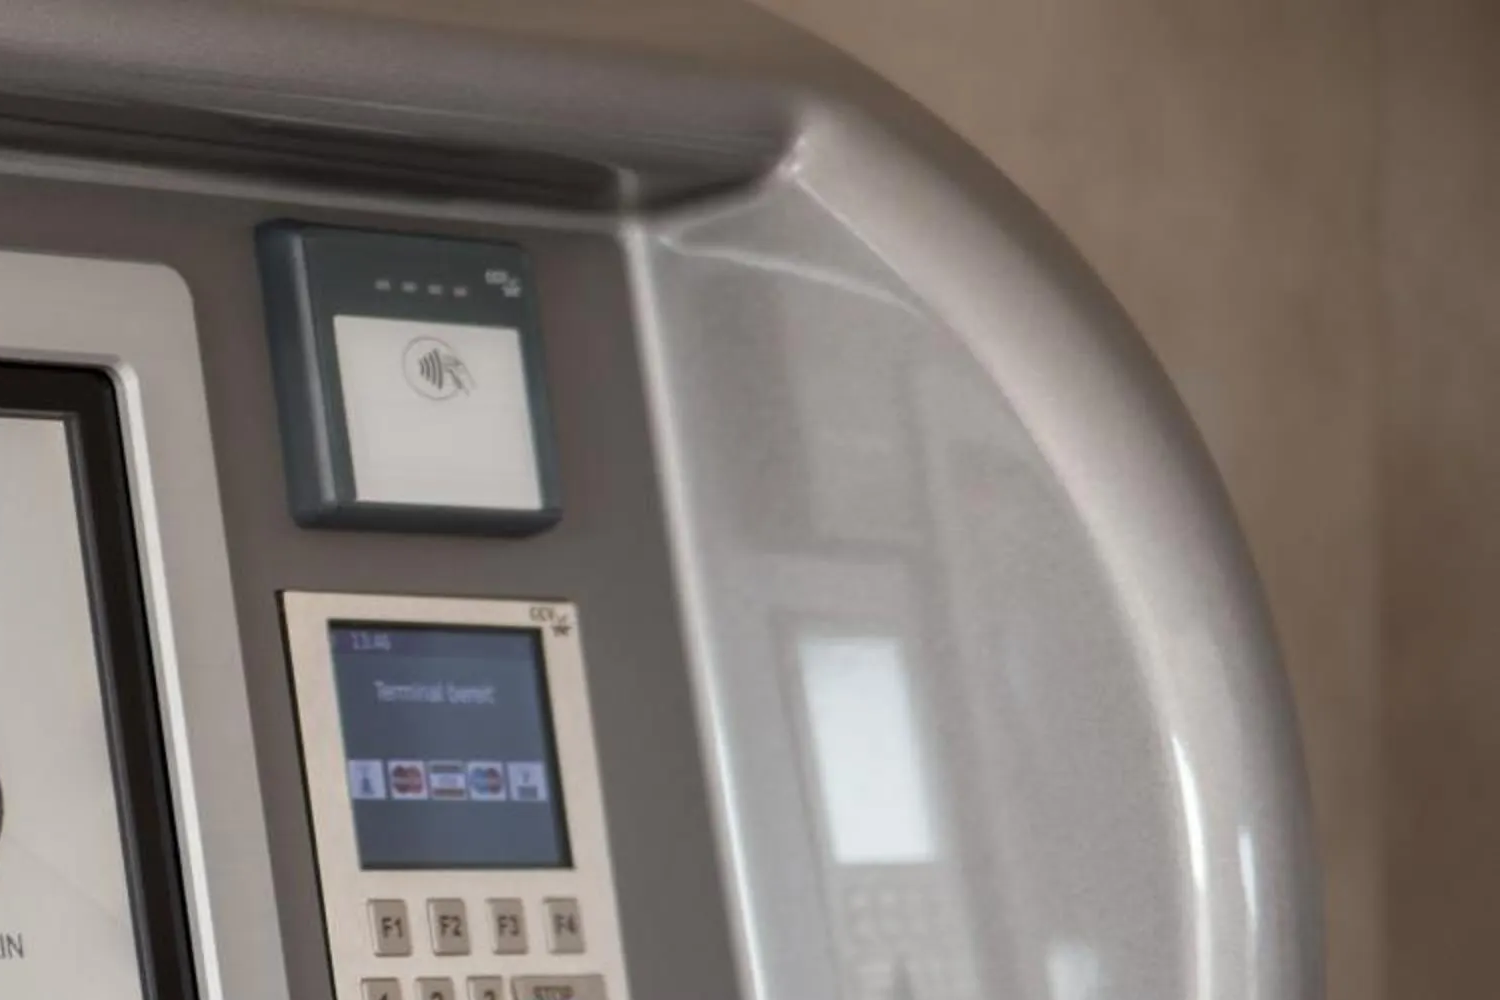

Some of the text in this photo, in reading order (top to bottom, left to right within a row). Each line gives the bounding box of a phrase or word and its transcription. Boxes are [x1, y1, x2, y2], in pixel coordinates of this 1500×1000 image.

[381, 916, 405, 939] F1
[438, 915, 464, 937] F2
[497, 914, 520, 937] F3
[553, 913, 577, 936] F4
